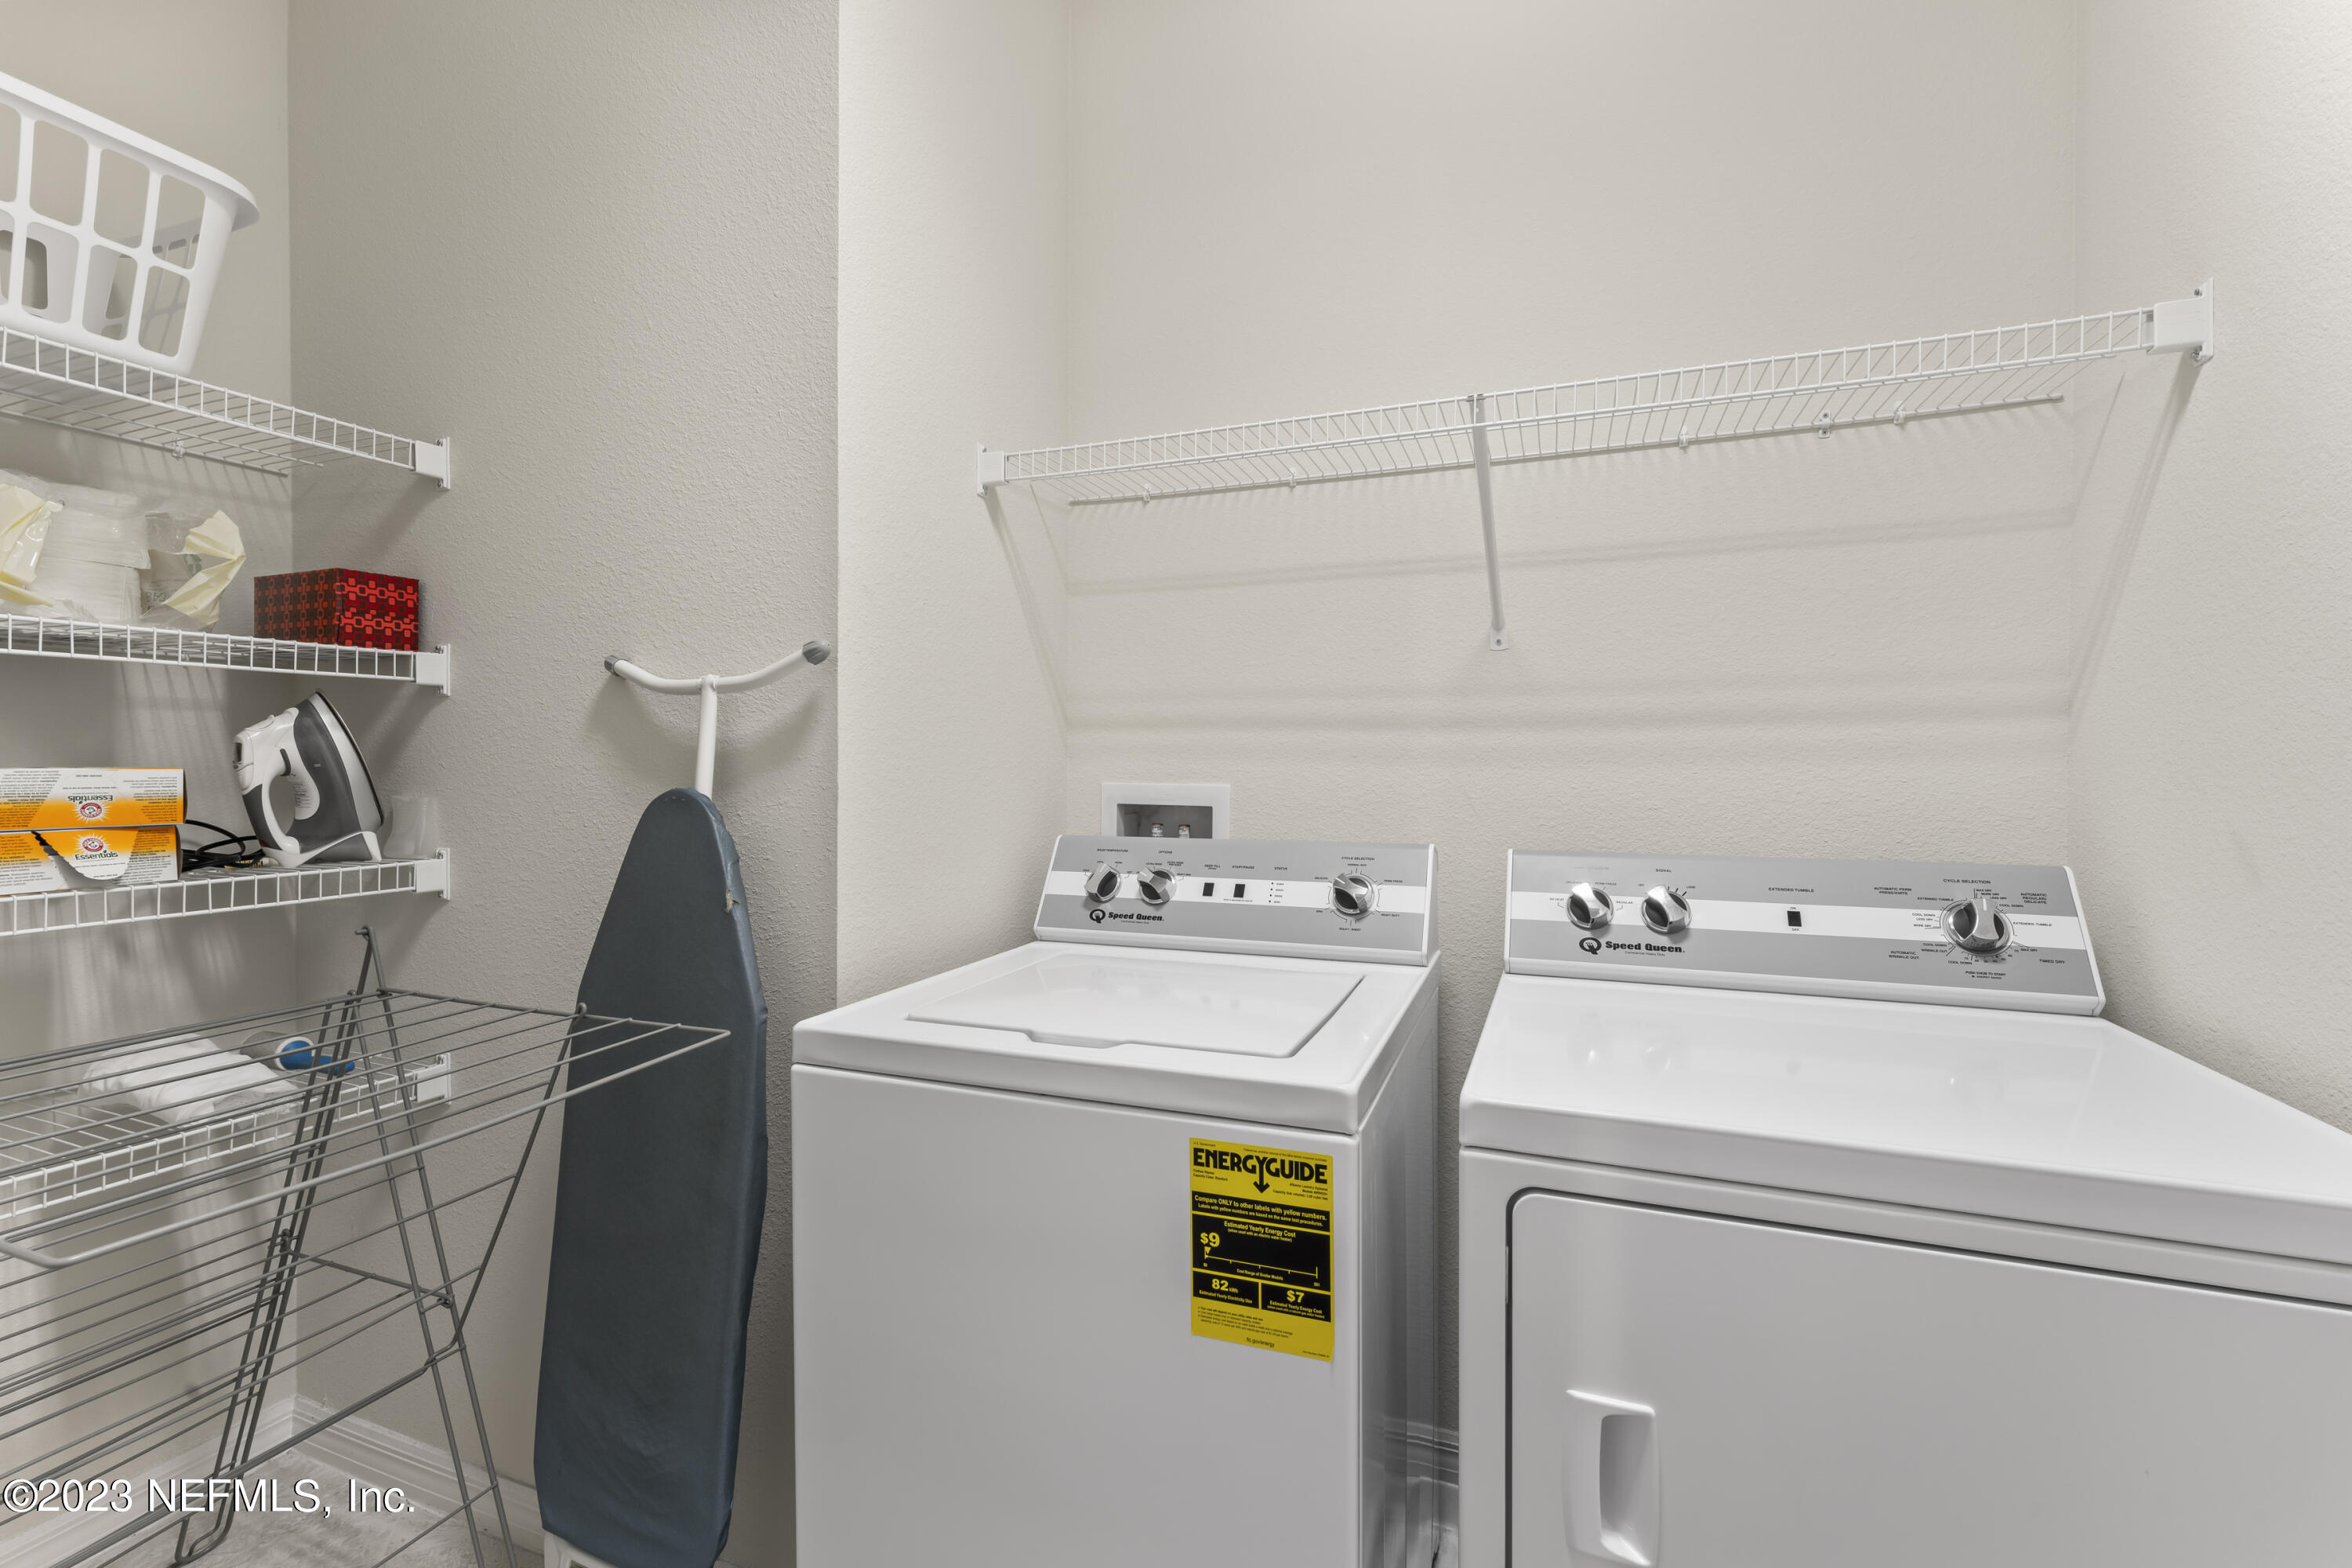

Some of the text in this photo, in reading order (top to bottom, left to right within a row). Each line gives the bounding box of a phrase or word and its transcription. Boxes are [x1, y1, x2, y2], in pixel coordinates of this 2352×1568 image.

[67, 795, 113, 804] Essentials
[74, 851, 118, 860] Essentials
[1605, 941, 1642, 951] Speed
[1645, 943, 1682, 953] Queen
[1193, 1147, 1327, 1185] ENERGYGUIDE
[1194, 1194, 1218, 1204] Compare
[1218, 1198, 1234, 1207] ONLY
[1254, 1203, 1270, 1212] labels
[1301, 1211, 1327, 1221] numbers.
[1224, 1220, 1248, 1230] Estimated
[1249, 1225, 1265, 1233] Yearly
[1265, 1227, 1283, 1236] Energy
[1200, 1231, 1220, 1247] $9
[1211, 1278, 1229, 1291] 82
[1227, 1294, 1245, 1303] Electricity
[1287, 1290, 1305, 1302] $7
[1300, 1305, 1312, 1313] Energy
